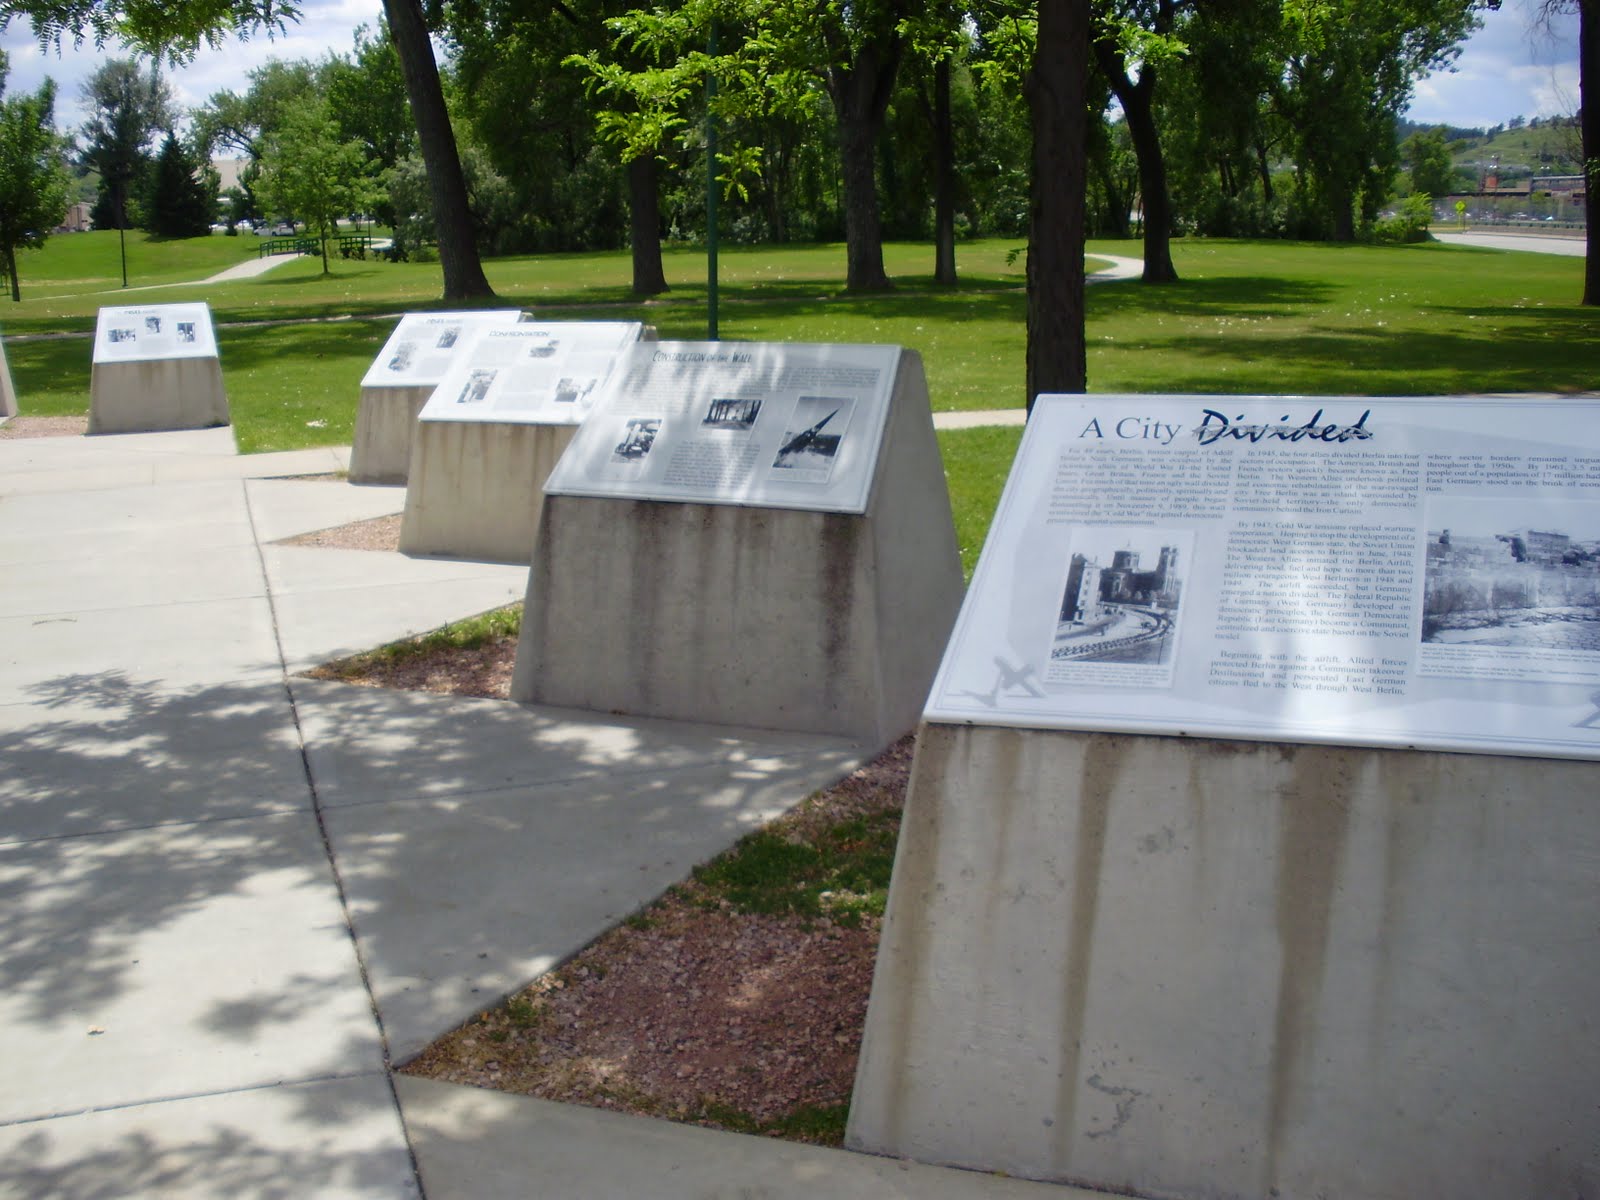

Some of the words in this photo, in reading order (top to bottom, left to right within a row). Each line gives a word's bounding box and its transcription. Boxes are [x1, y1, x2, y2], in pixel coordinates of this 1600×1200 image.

[732, 352, 752, 363] WALL
[1078, 417, 1104, 438] A
[1116, 416, 1182, 445] City
[1199, 409, 1372, 445] Divided
[1427, 461, 1468, 470] throughout
[1427, 469, 1452, 478] people
[1486, 470, 1528, 480] population
[1387, 476, 1418, 485] political
[1349, 532, 1399, 542] development
[1352, 601, 1393, 611] developed
